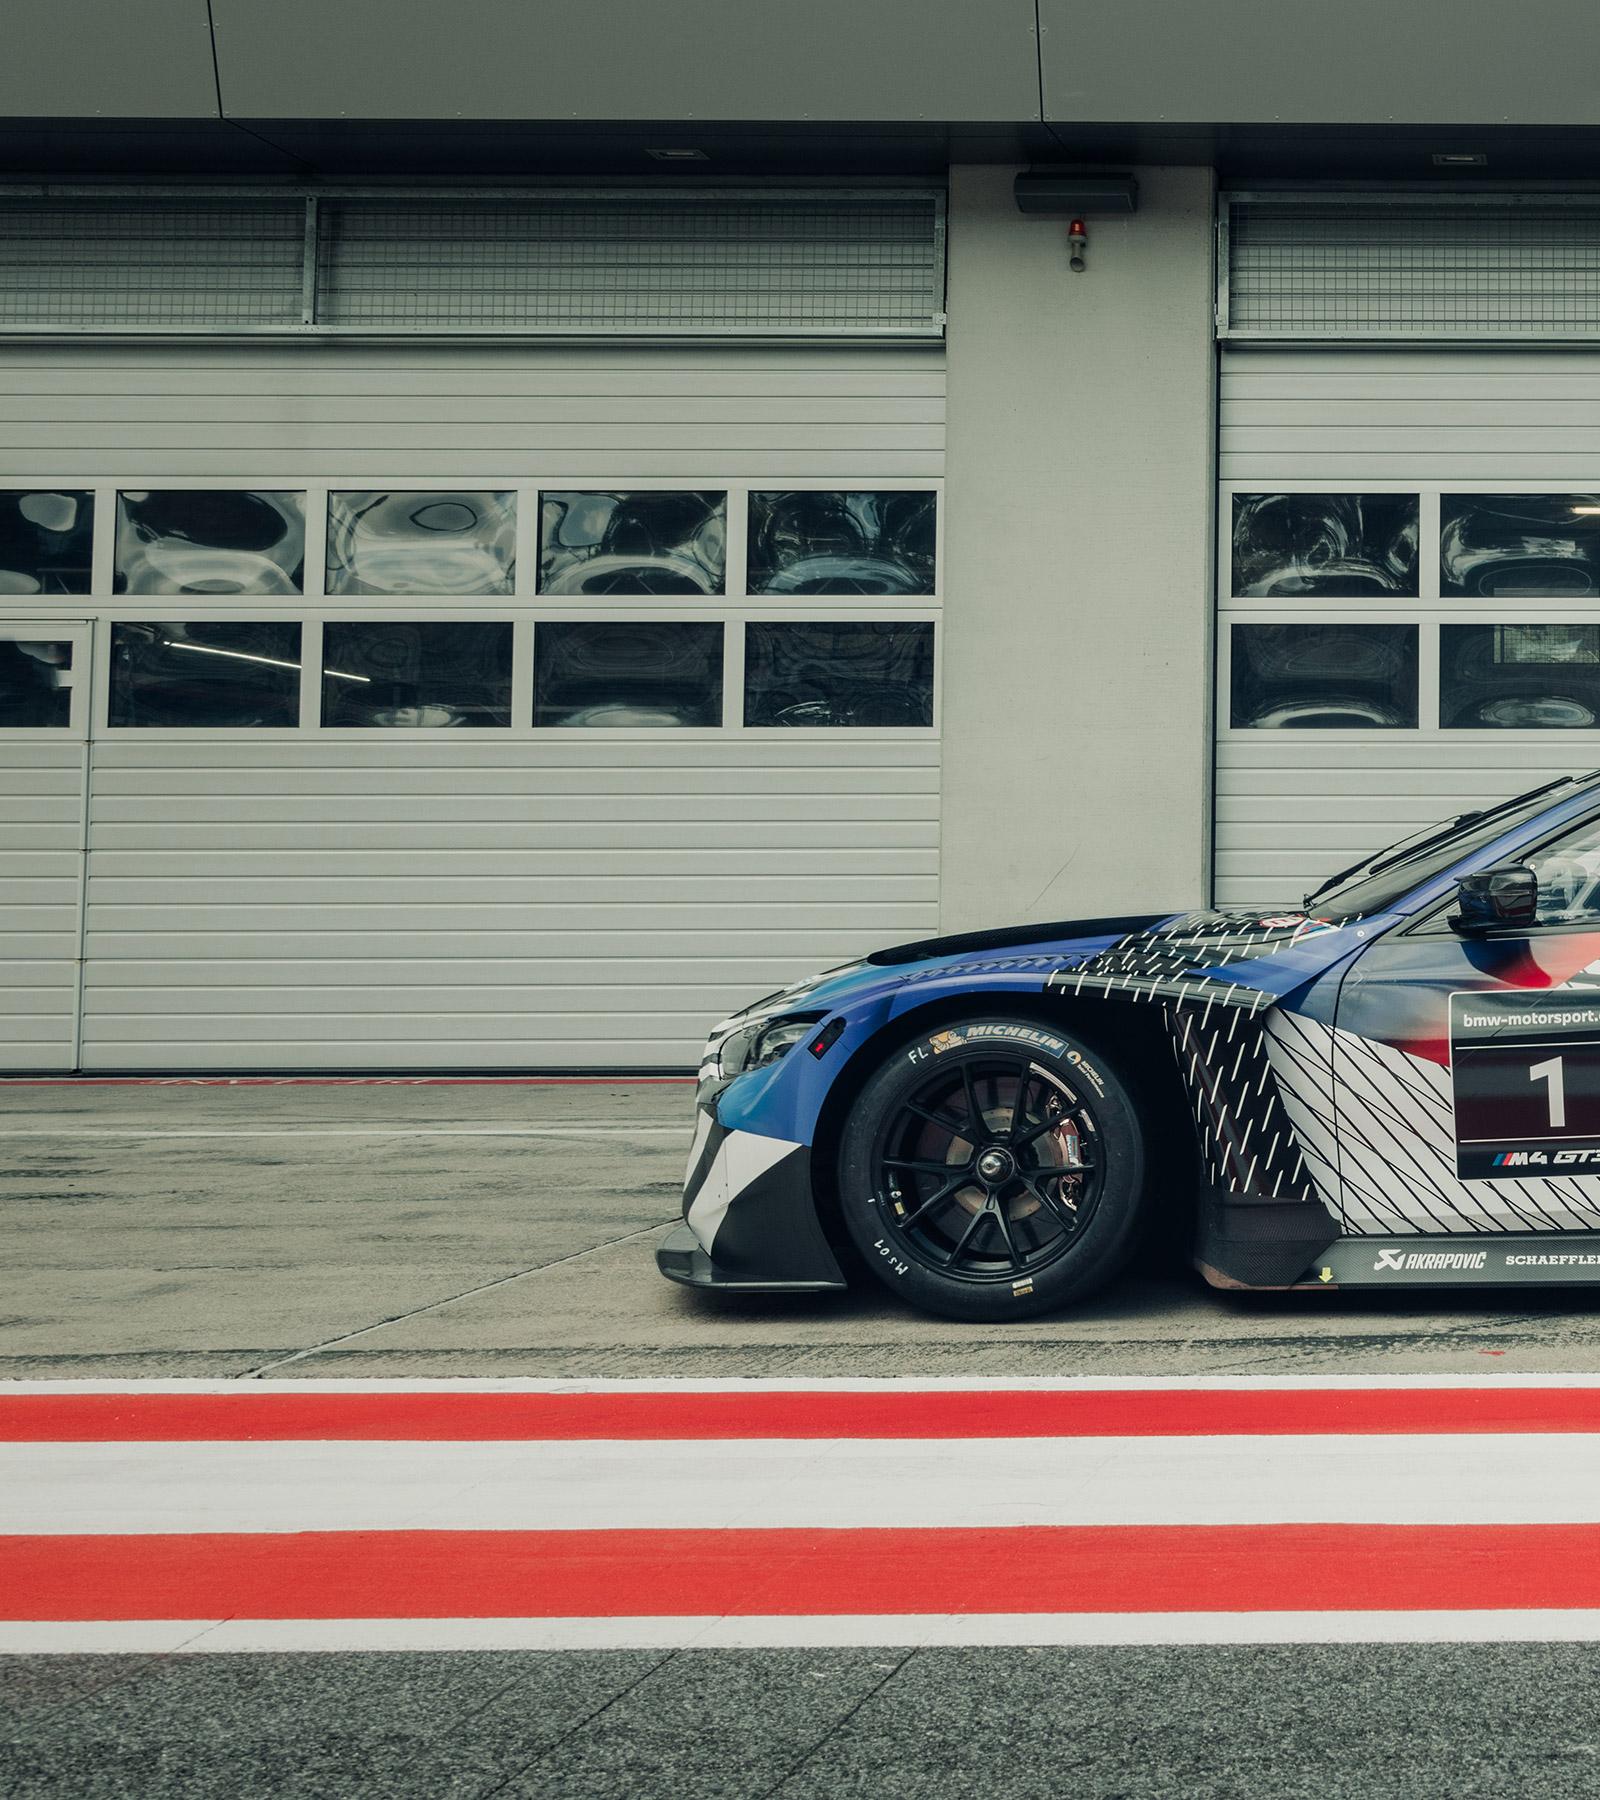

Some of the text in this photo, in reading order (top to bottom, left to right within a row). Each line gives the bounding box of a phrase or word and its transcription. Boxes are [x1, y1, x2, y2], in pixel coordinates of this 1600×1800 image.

[966, 1024, 1065, 1051] MICHELIN
[908, 1046, 929, 1064] FL
[1529, 1055, 1566, 1128] 1
